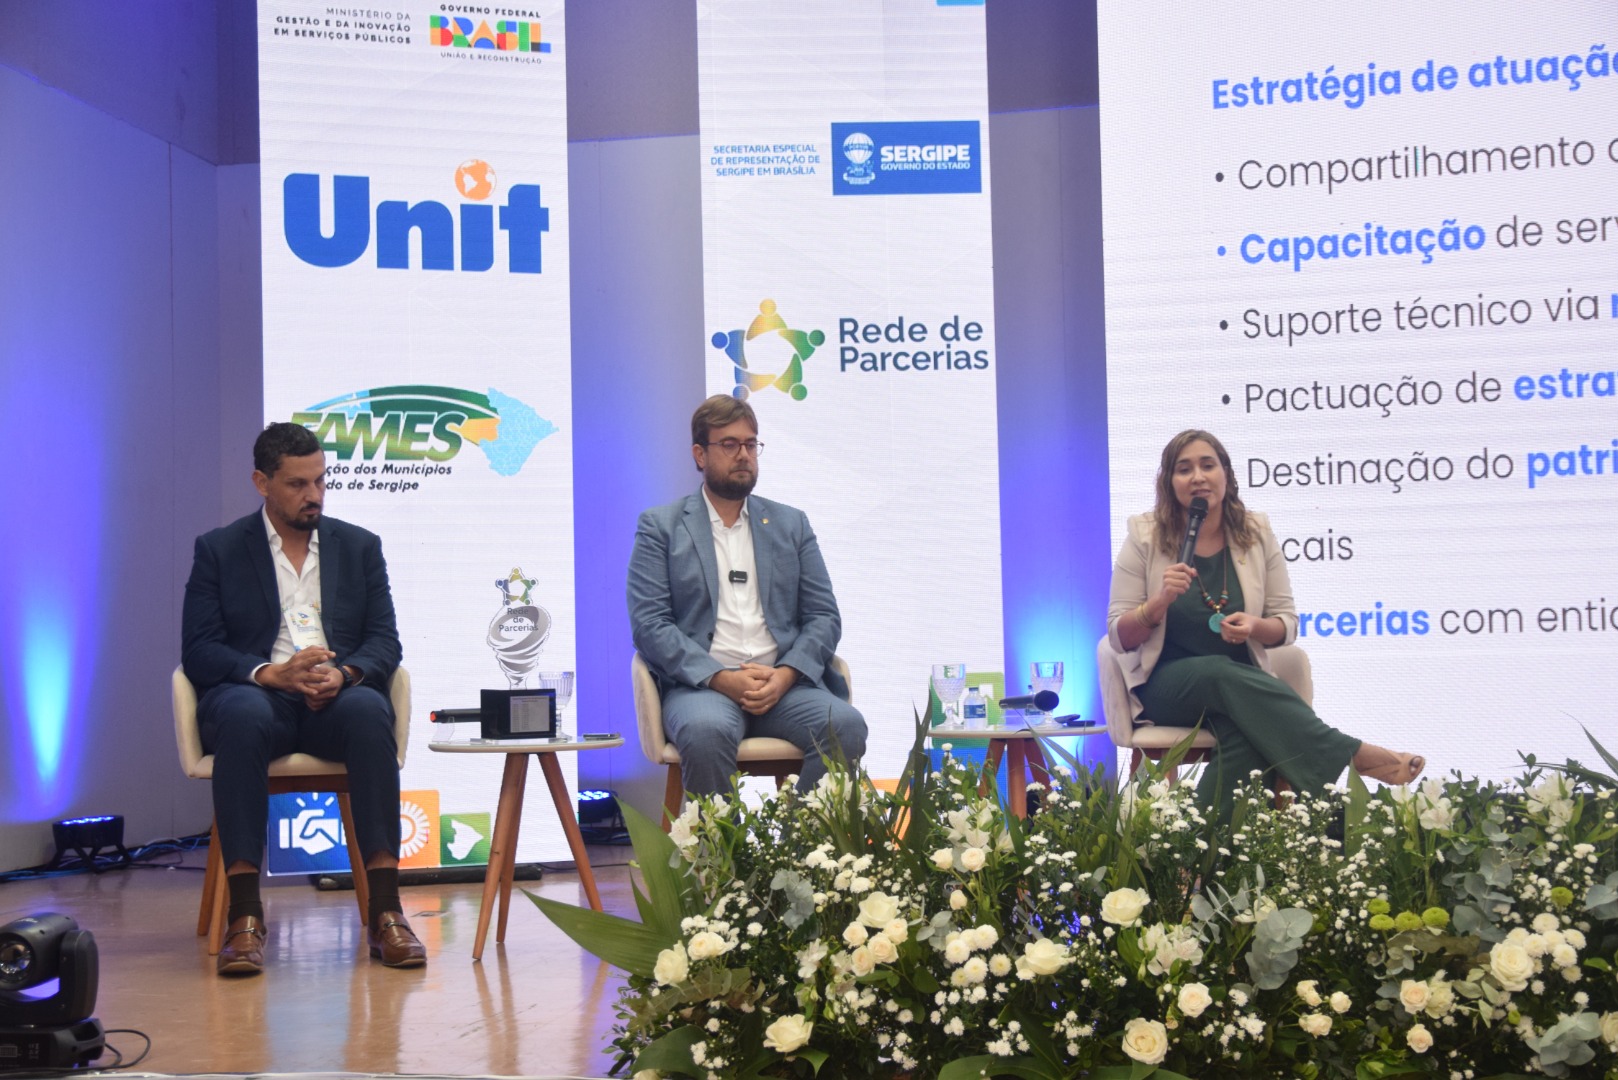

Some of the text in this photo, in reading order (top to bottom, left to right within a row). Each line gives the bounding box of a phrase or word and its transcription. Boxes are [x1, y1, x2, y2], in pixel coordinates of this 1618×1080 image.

[326, 8, 411, 20] MINISTÉRIO DA
[440, 4, 541, 18] GOVERNO FEDERAL
[276, 16, 320, 26] GESTÃO
[336, 20, 349, 28] DA
[354, 22, 411, 32] INOVAÇÃO
[274, 28, 411, 44] EM SERVIÇOS PÚBLICOS
[430, 15, 551, 53] BRASIL
[440, 52, 467, 60] UNIÃO
[478, 54, 542, 64] RECONSTRUÇÃO
[1212, 44, 1618, 110] Estratégia de atuaçã
[713, 144, 817, 154] SECRETARIA ESPECIAL
[880, 144, 971, 163] SERGIPE
[711, 154, 821, 165] DE REPRESENTAÇÃO DE
[881, 162, 971, 171] GOVERNO DO ESTADO
[1239, 136, 1595, 195] Compartilhamento
[716, 165, 816, 176] SERGIPE EM BRASÍLIA
[283, 158, 550, 274] Unit
[1240, 215, 1618, 272] Capacitação de ser
[1243, 303, 1382, 346] Suporte
[1394, 293, 1532, 331] técnico
[1543, 288, 1599, 321] via
[839, 315, 983, 343] Rede de
[840, 344, 989, 372] Parcerias
[1245, 368, 1618, 418] Pactuação de estra
[326, 463, 453, 477] ção dos Municípios
[1248, 439, 1618, 493] Destinação do patri
[347, 479, 364, 490] de
[368, 479, 419, 493] Sergipe
[1281, 528, 1354, 562] cais
[507, 607, 529, 615] Rede
[1298, 602, 1430, 637] rcerias
[1440, 608, 1523, 634] com
[499, 624, 539, 632] Parcerias
